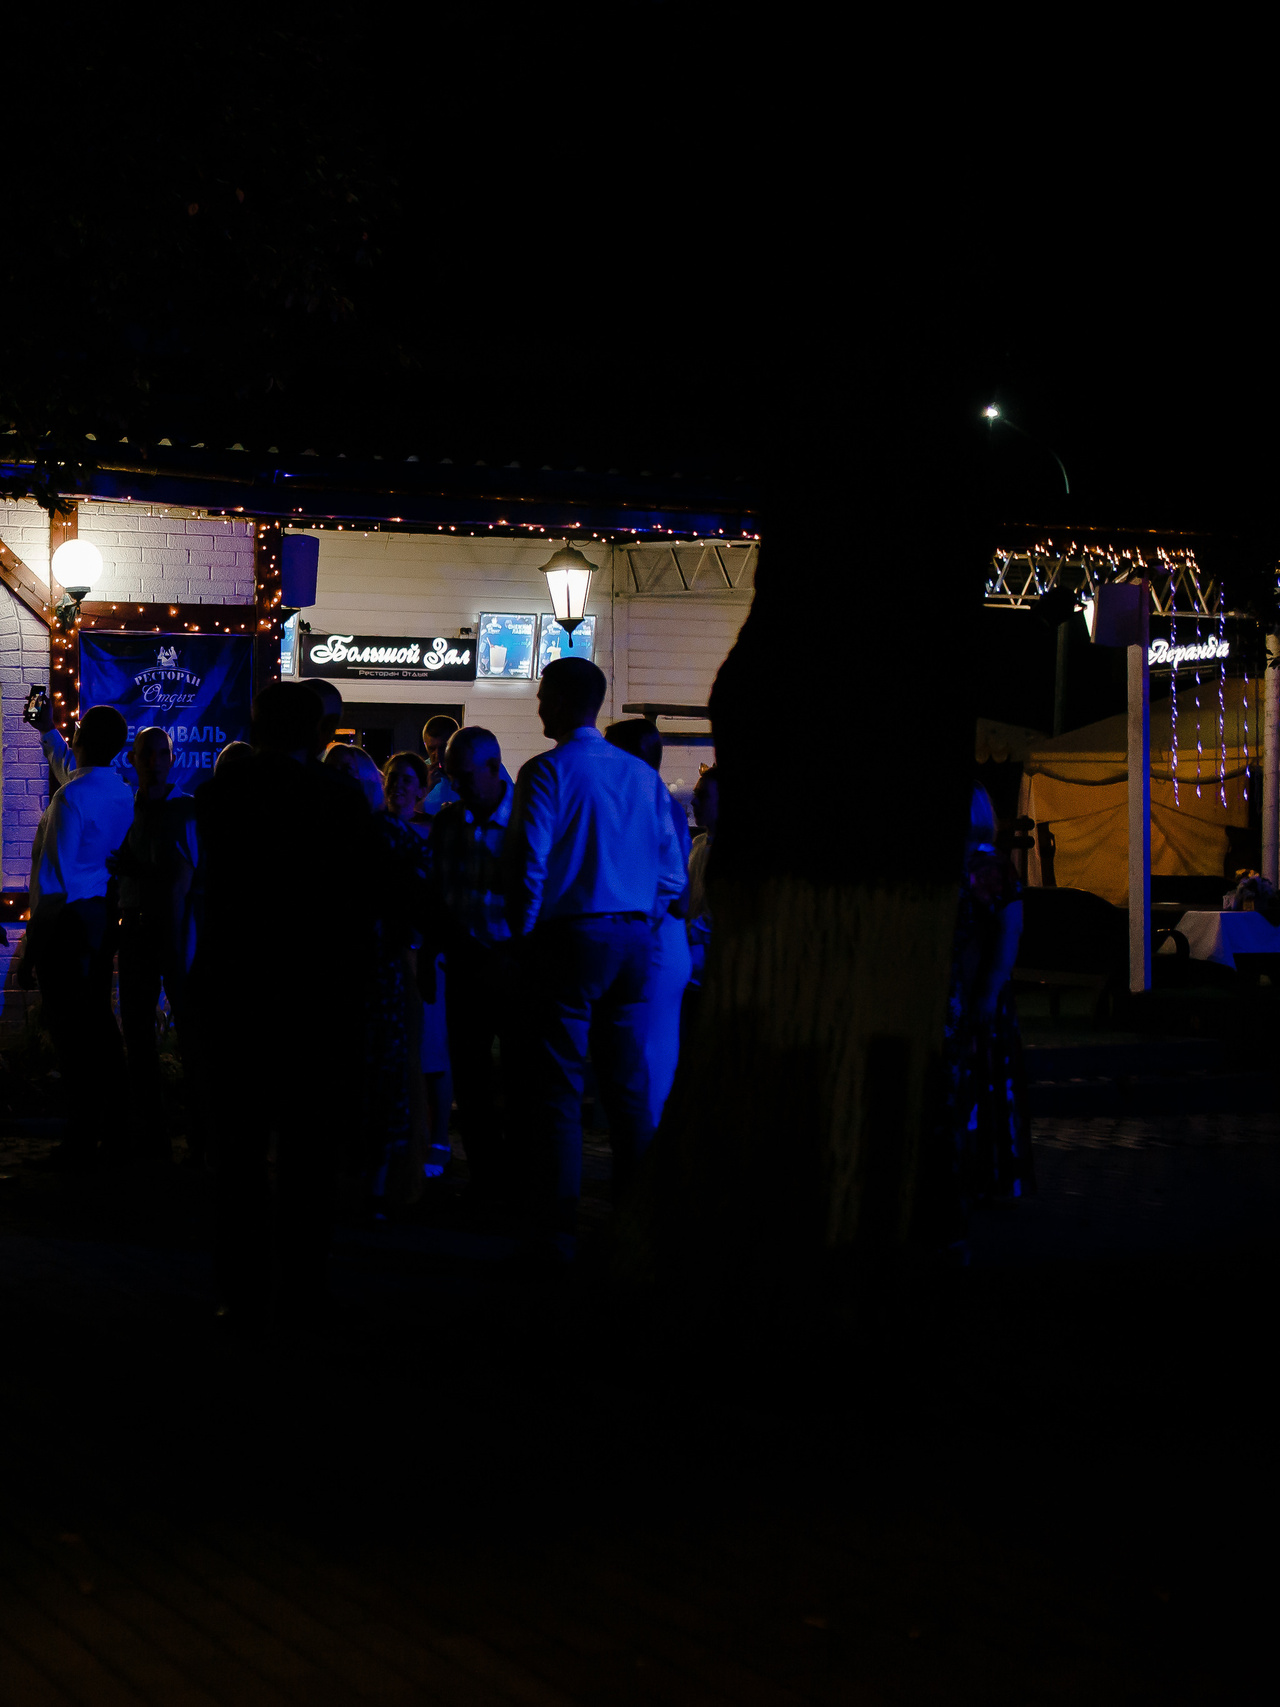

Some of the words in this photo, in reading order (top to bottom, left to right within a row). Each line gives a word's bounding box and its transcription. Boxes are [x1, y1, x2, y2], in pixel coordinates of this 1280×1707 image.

[310, 635, 420, 664] Большой
[423, 637, 470, 670] Зал
[1148, 633, 1230, 672] Веранда
[134, 670, 202, 688] РЕСТОРАН
[358, 669, 400, 678] Ресторан
[402, 670, 429, 679] Отдых
[142, 683, 197, 711] Отдых
